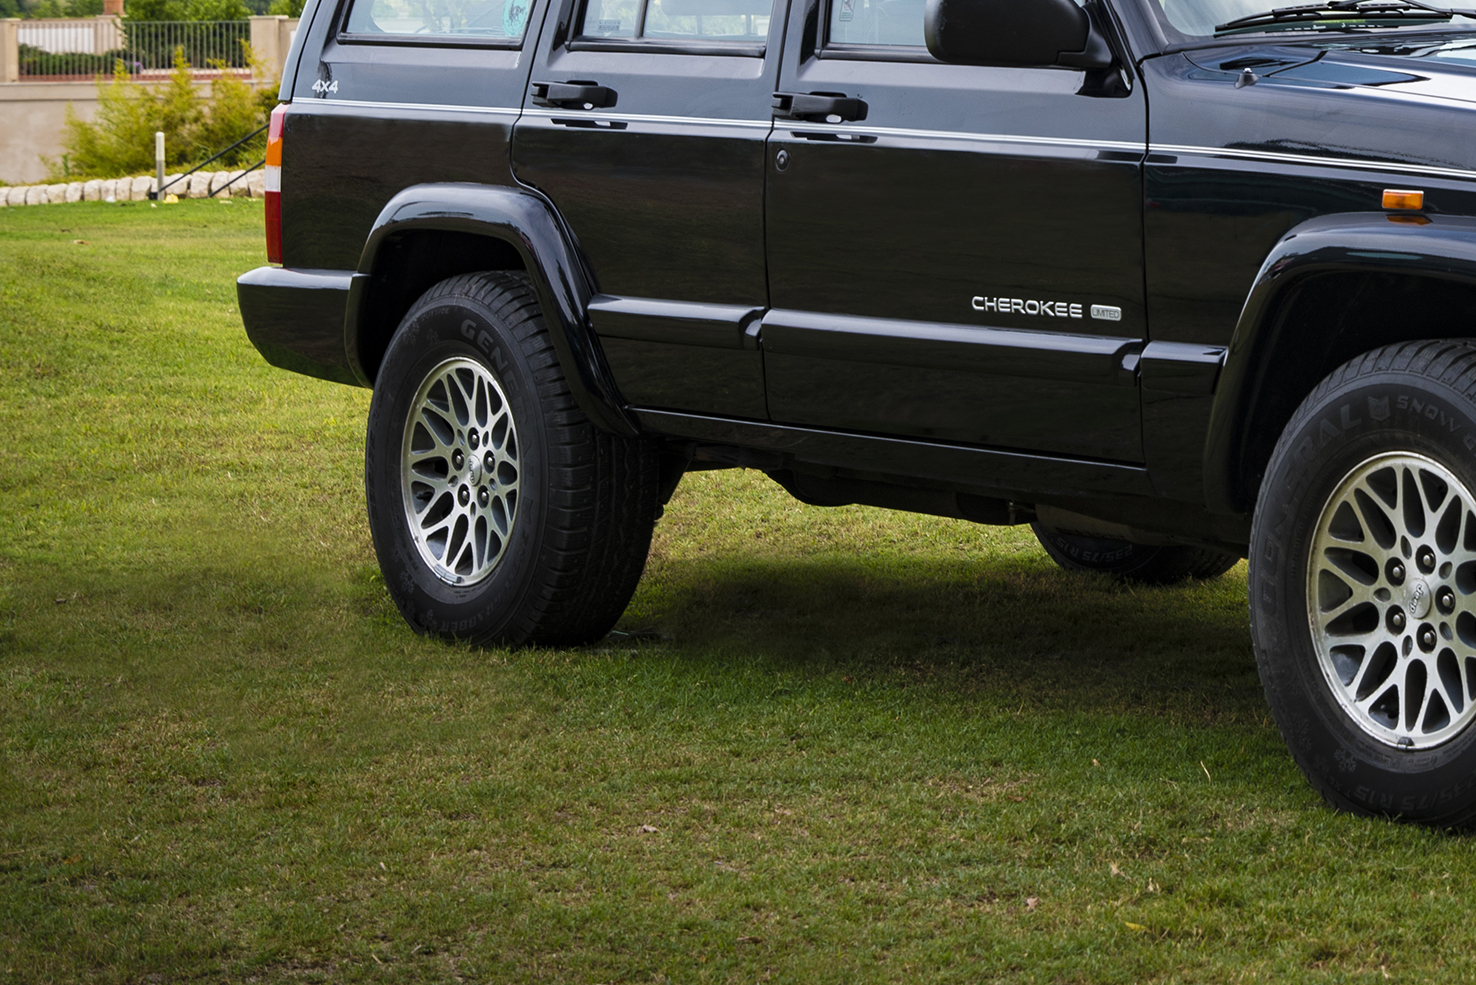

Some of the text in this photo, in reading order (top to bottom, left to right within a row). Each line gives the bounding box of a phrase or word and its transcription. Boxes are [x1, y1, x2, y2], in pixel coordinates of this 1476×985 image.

[311, 78, 339, 94] 4x4
[971, 295, 1120, 319] CHEROKEE LIMITED
[1409, 583, 1424, 614] Jeep
